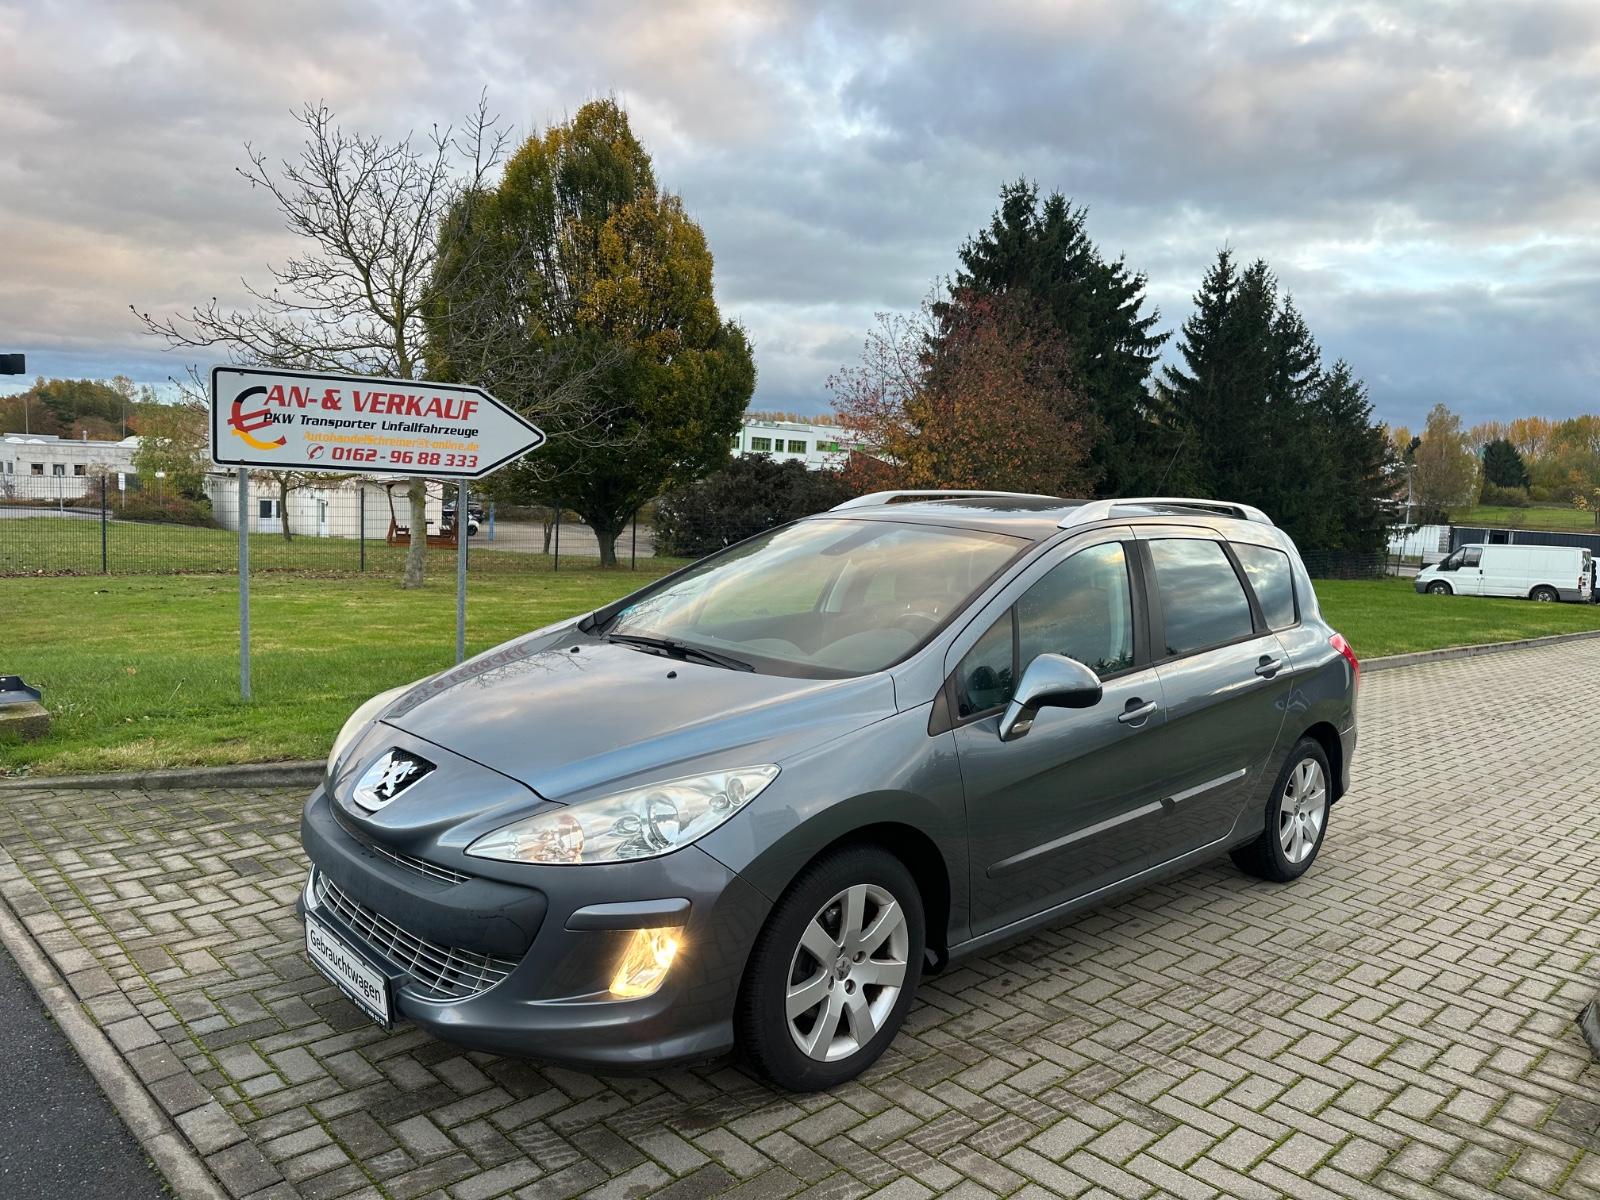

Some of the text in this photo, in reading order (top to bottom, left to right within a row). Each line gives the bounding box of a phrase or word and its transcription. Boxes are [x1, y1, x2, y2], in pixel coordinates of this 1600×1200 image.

[321, 388, 342, 411] &
[352, 390, 479, 421] VERKAUF
[263, 412, 479, 439] PKW Transporter Unfallfahrzeuge
[331, 446, 378, 462] 0162
[389, 450, 413, 465] 96
[417, 452, 441, 466] 88
[444, 453, 479, 468] 333
[309, 928, 382, 1004] Gebrauchtwagen
